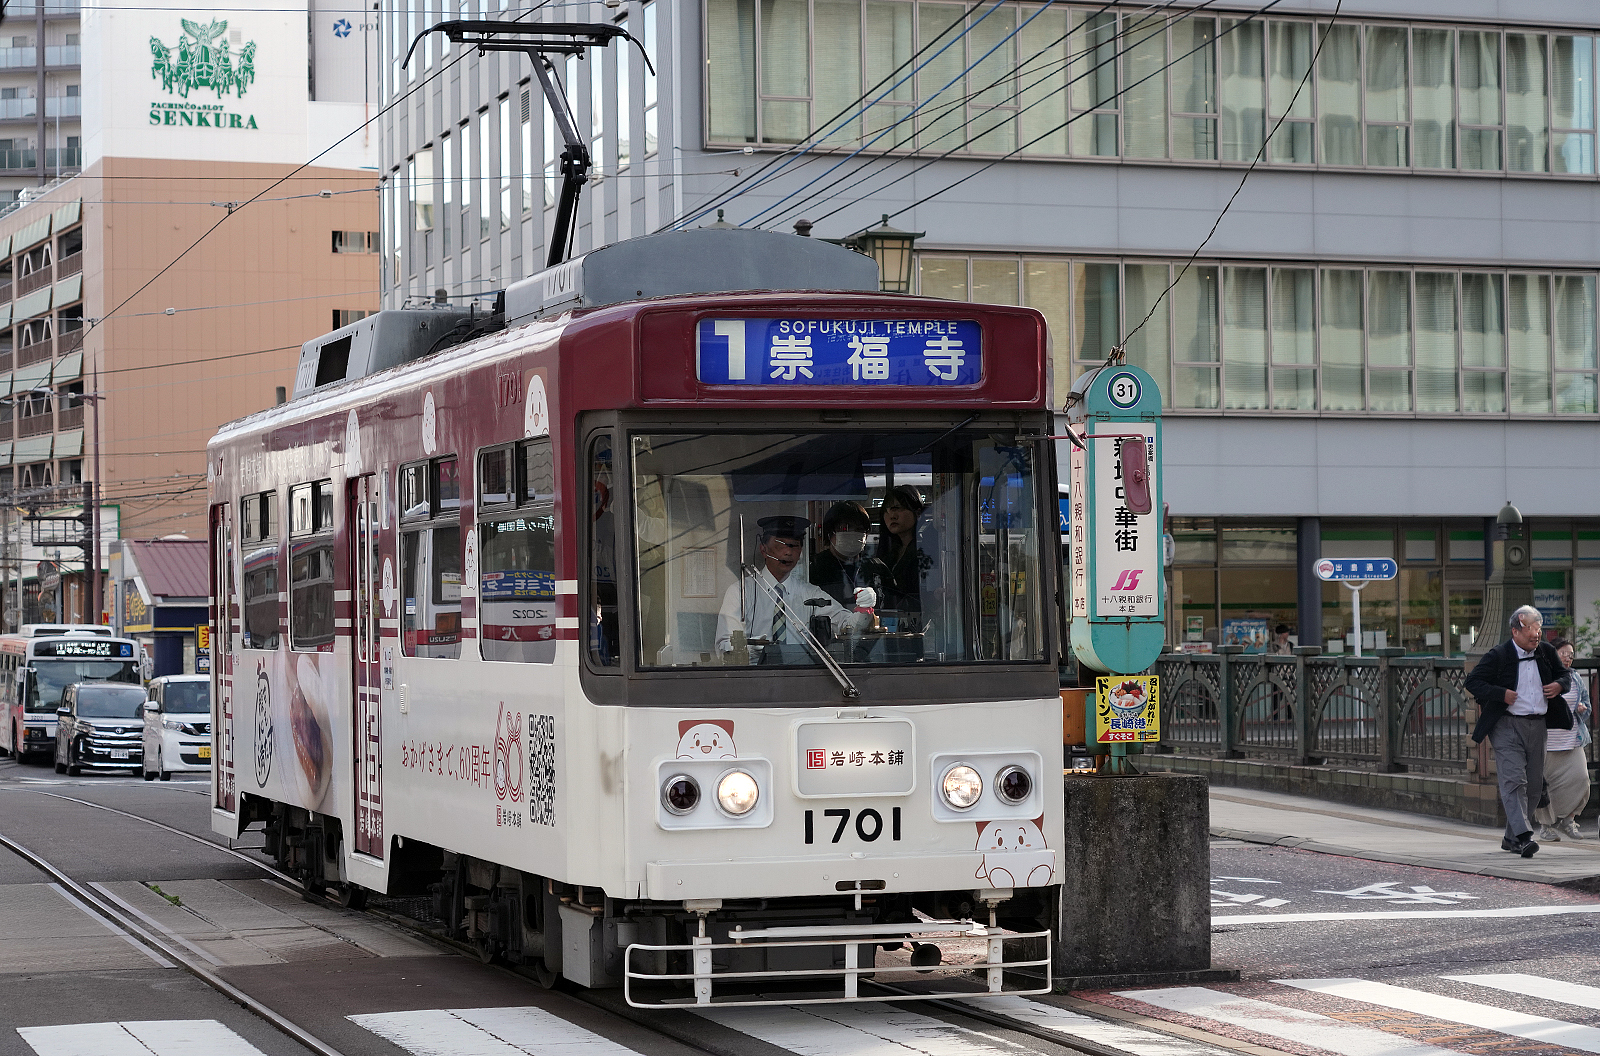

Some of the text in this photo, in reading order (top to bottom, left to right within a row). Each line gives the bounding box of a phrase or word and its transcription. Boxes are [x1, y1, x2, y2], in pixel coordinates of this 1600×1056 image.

[149, 109, 259, 130] SENKURA
[779, 320, 875, 335] SOFUKUJI
[884, 321, 958, 335] TEMPLE
[714, 320, 746, 380] 1
[769, 334, 966, 381] 崇福寺
[1115, 383, 1135, 398] 31
[1101, 594, 1153, 604] 十八親和銀行
[1118, 604, 1136, 613] 本店
[1109, 717, 1147, 730] 長崎港
[1107, 732, 1134, 741] すぐそこ
[829, 748, 905, 768] 岩崎本舗
[804, 806, 902, 845] 1701
